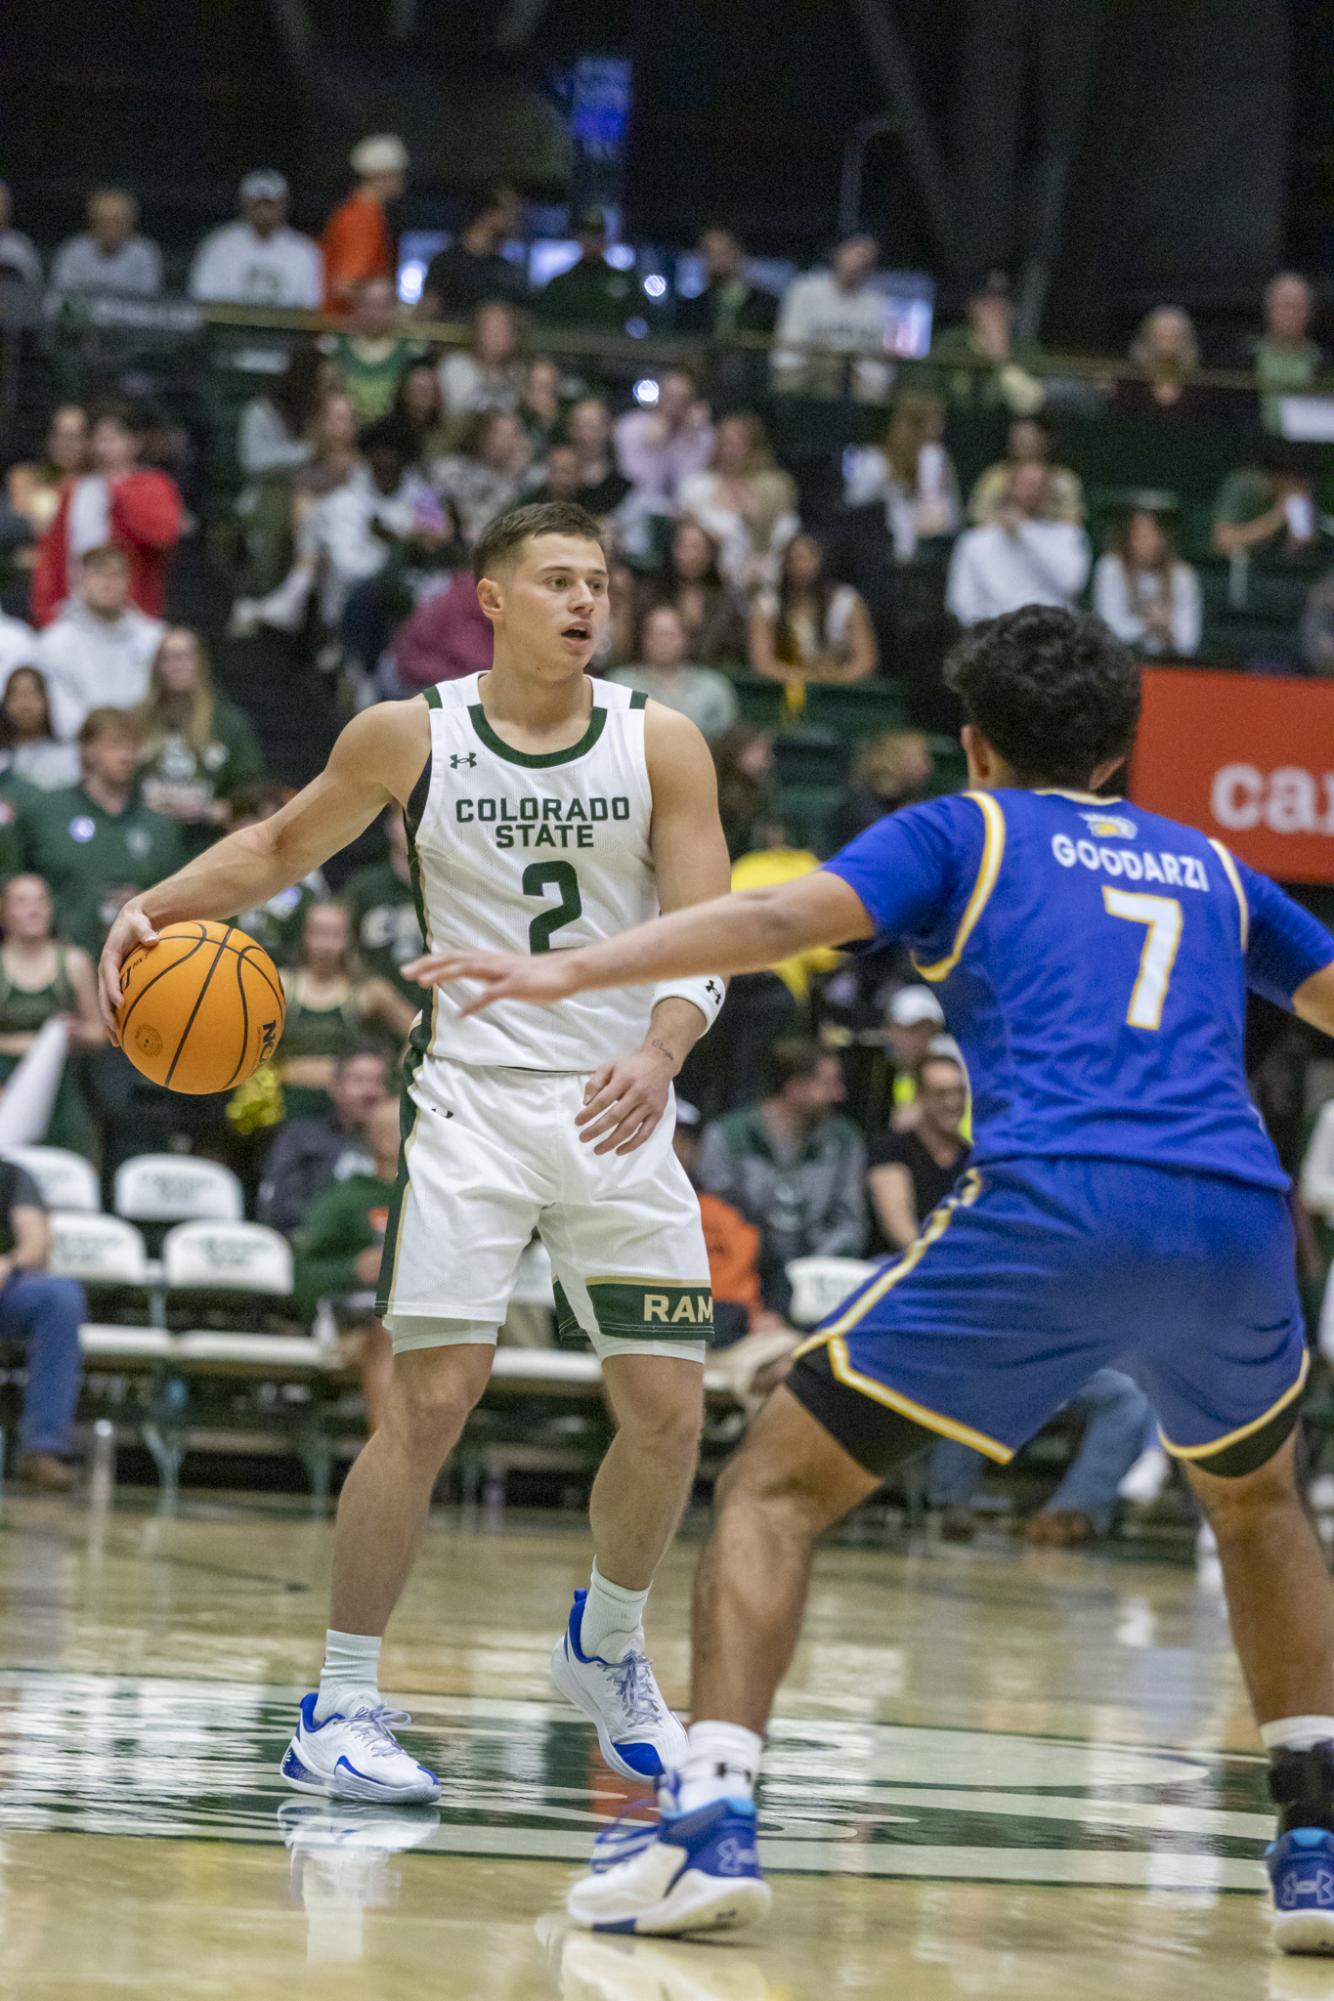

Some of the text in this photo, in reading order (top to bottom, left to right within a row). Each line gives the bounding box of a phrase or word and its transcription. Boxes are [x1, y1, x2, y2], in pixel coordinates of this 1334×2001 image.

[456, 797, 630, 823] COLORADO
[495, 824, 594, 848] STATE
[1052, 834, 1209, 892] GOODARZI
[522, 860, 583, 955] 2
[1101, 885, 1184, 1030] 7
[644, 1294, 713, 1323] RAM
